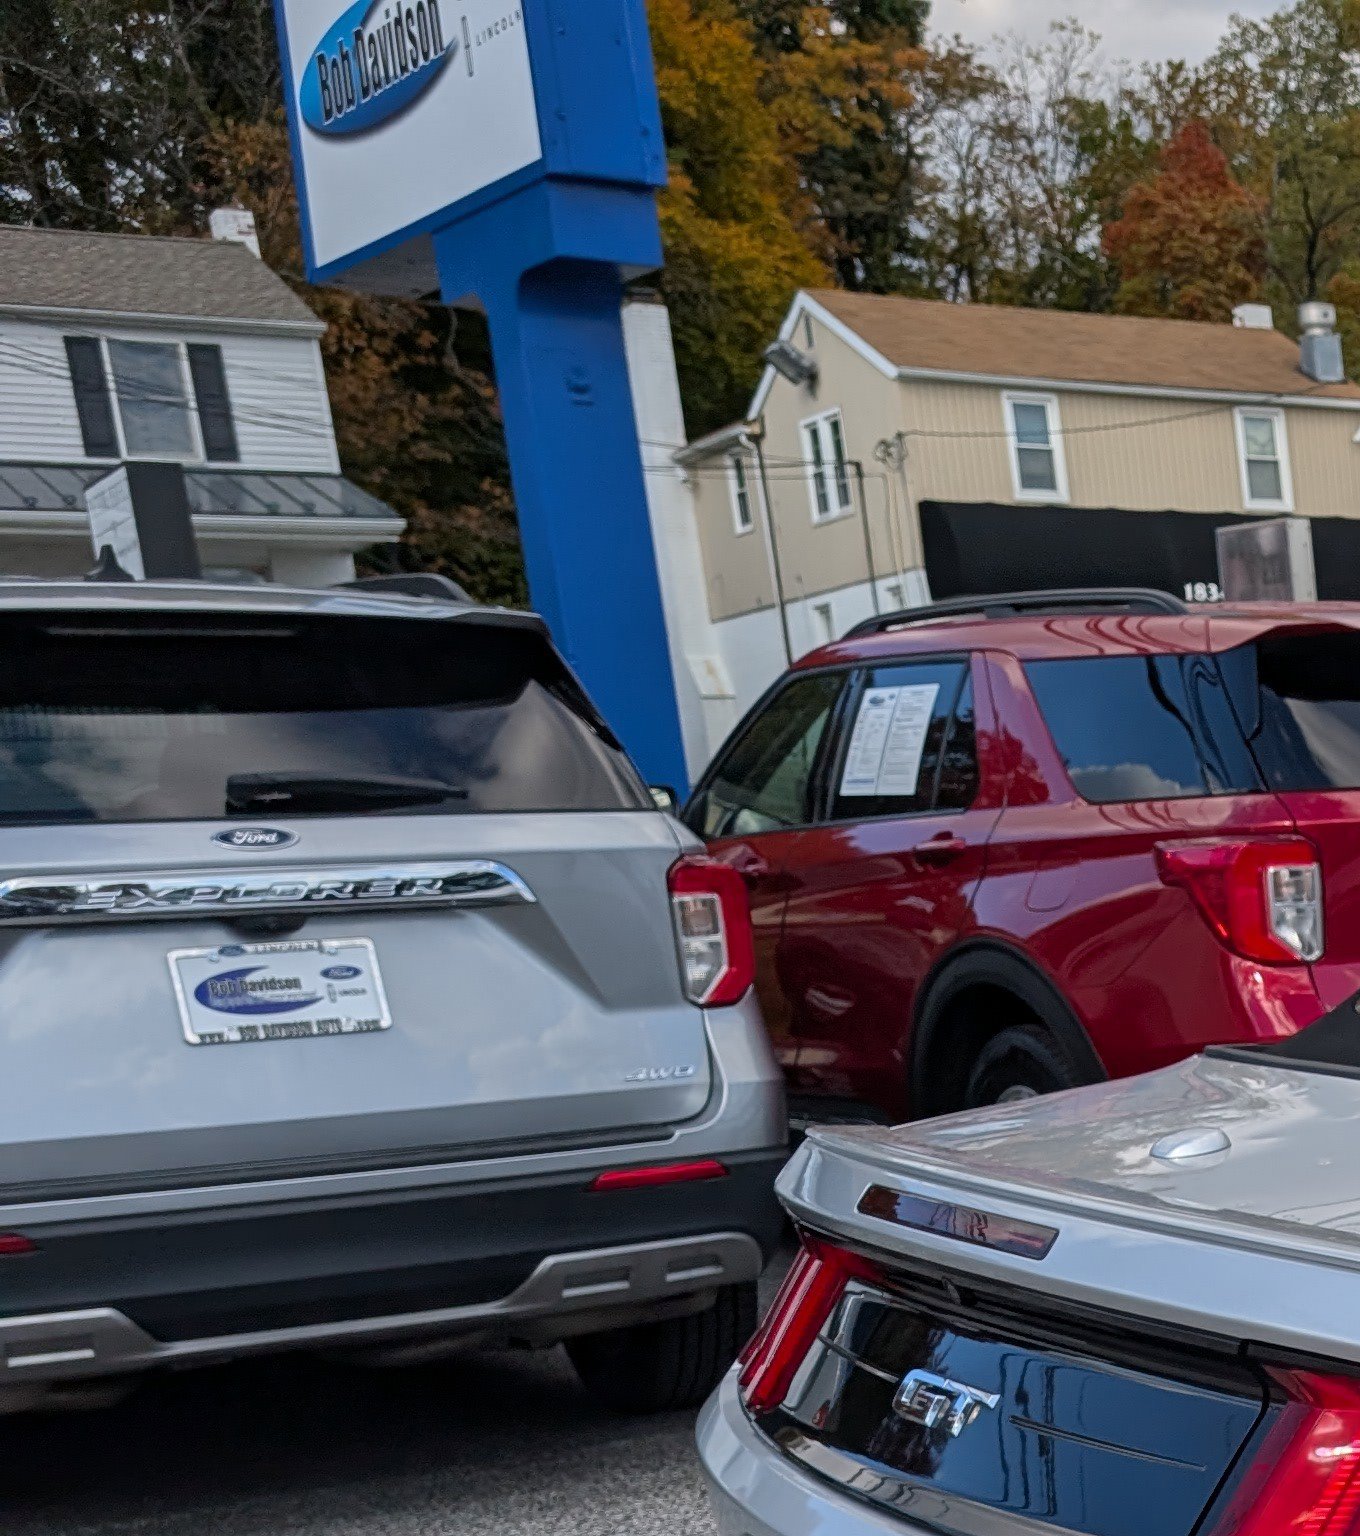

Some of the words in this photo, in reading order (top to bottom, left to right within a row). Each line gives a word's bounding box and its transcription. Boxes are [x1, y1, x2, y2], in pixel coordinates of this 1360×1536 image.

[475, 10, 521, 47] LINCOLN
[315, 38, 356, 124] Bob
[353, 0, 446, 102] Davidson
[233, 831, 279, 845] Ford
[75, 878, 444, 911] EXPLORER
[892, 1368, 1000, 1437] GT
